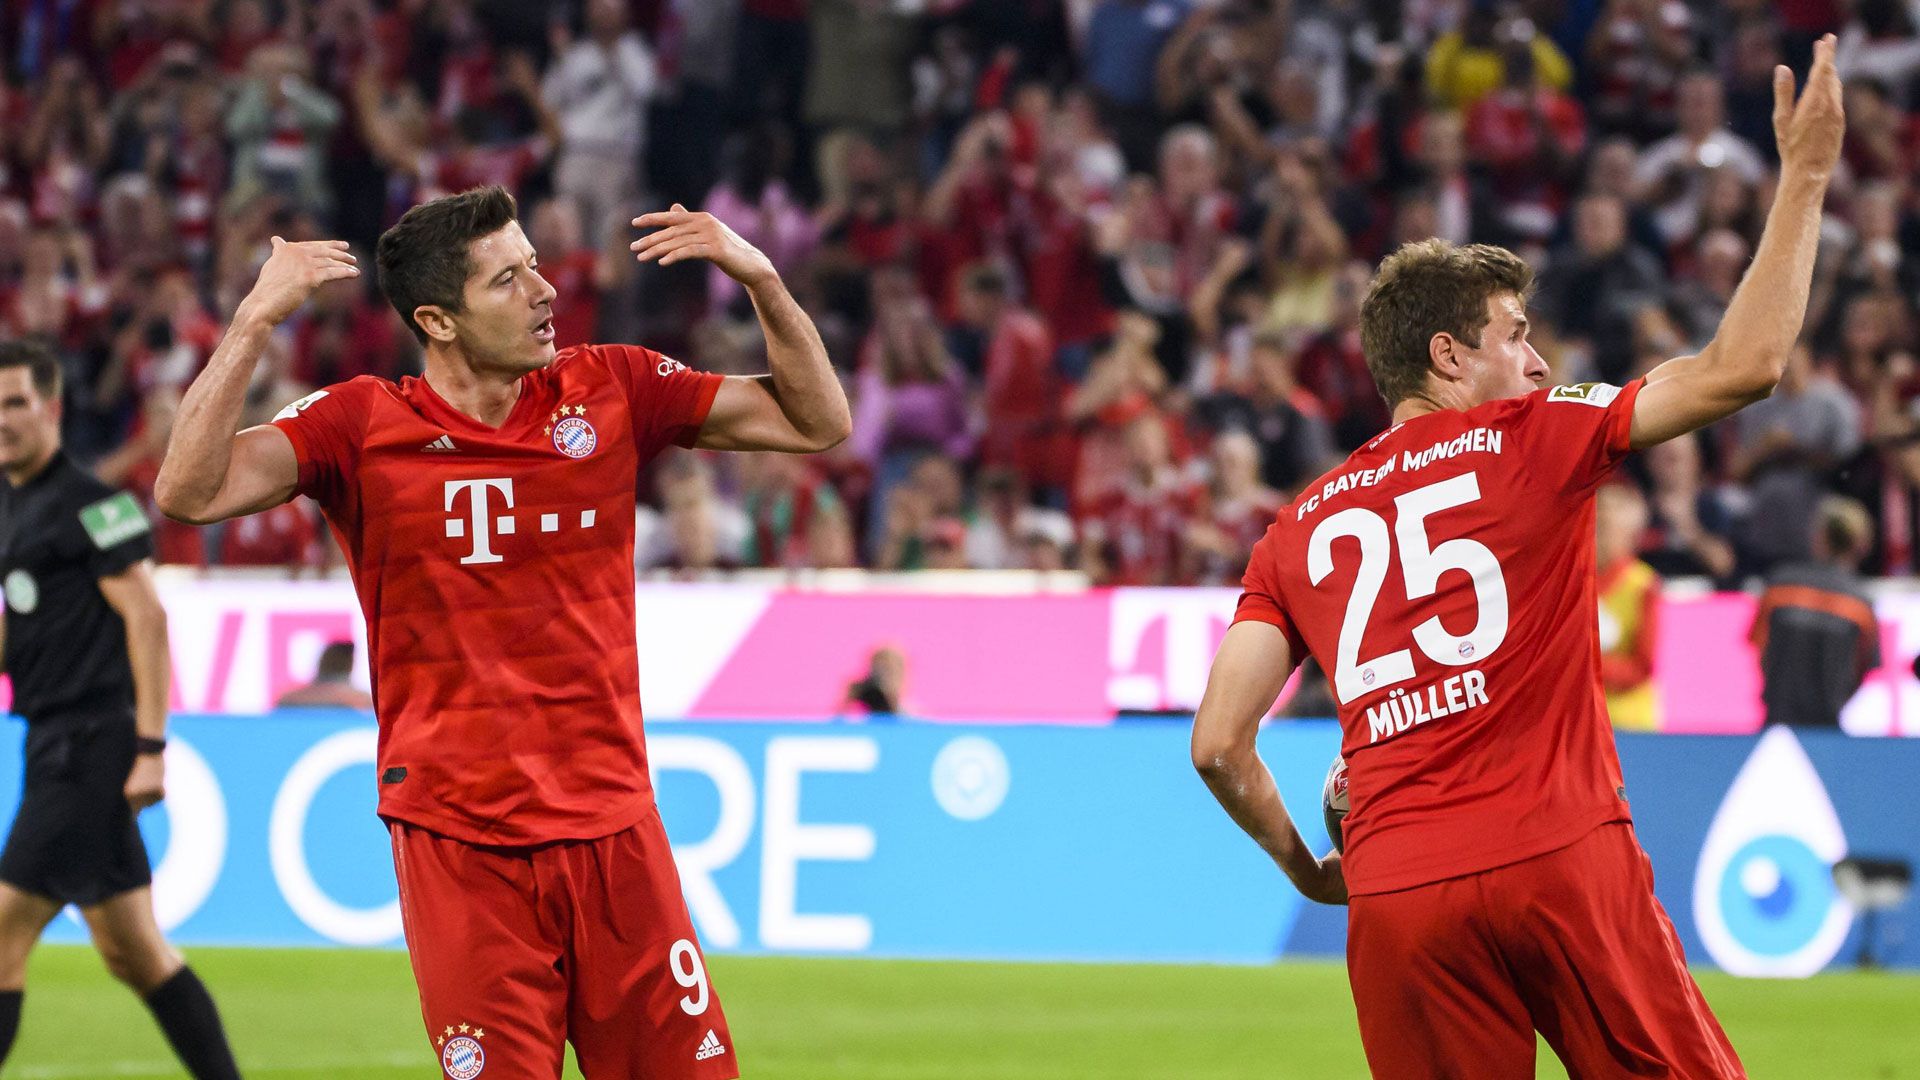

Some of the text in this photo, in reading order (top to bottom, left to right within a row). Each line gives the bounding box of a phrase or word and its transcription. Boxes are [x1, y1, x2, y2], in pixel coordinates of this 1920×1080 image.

[1297, 494, 1320, 521] FC
[1322, 453, 1397, 502] BAYERN
[1307, 471, 1509, 705] 25
[1366, 669, 1490, 744] MÜLLER
[669, 938, 710, 1016] 9
[451, 1039, 480, 1054] BAYERN
[695, 1045, 726, 1061] adidas
